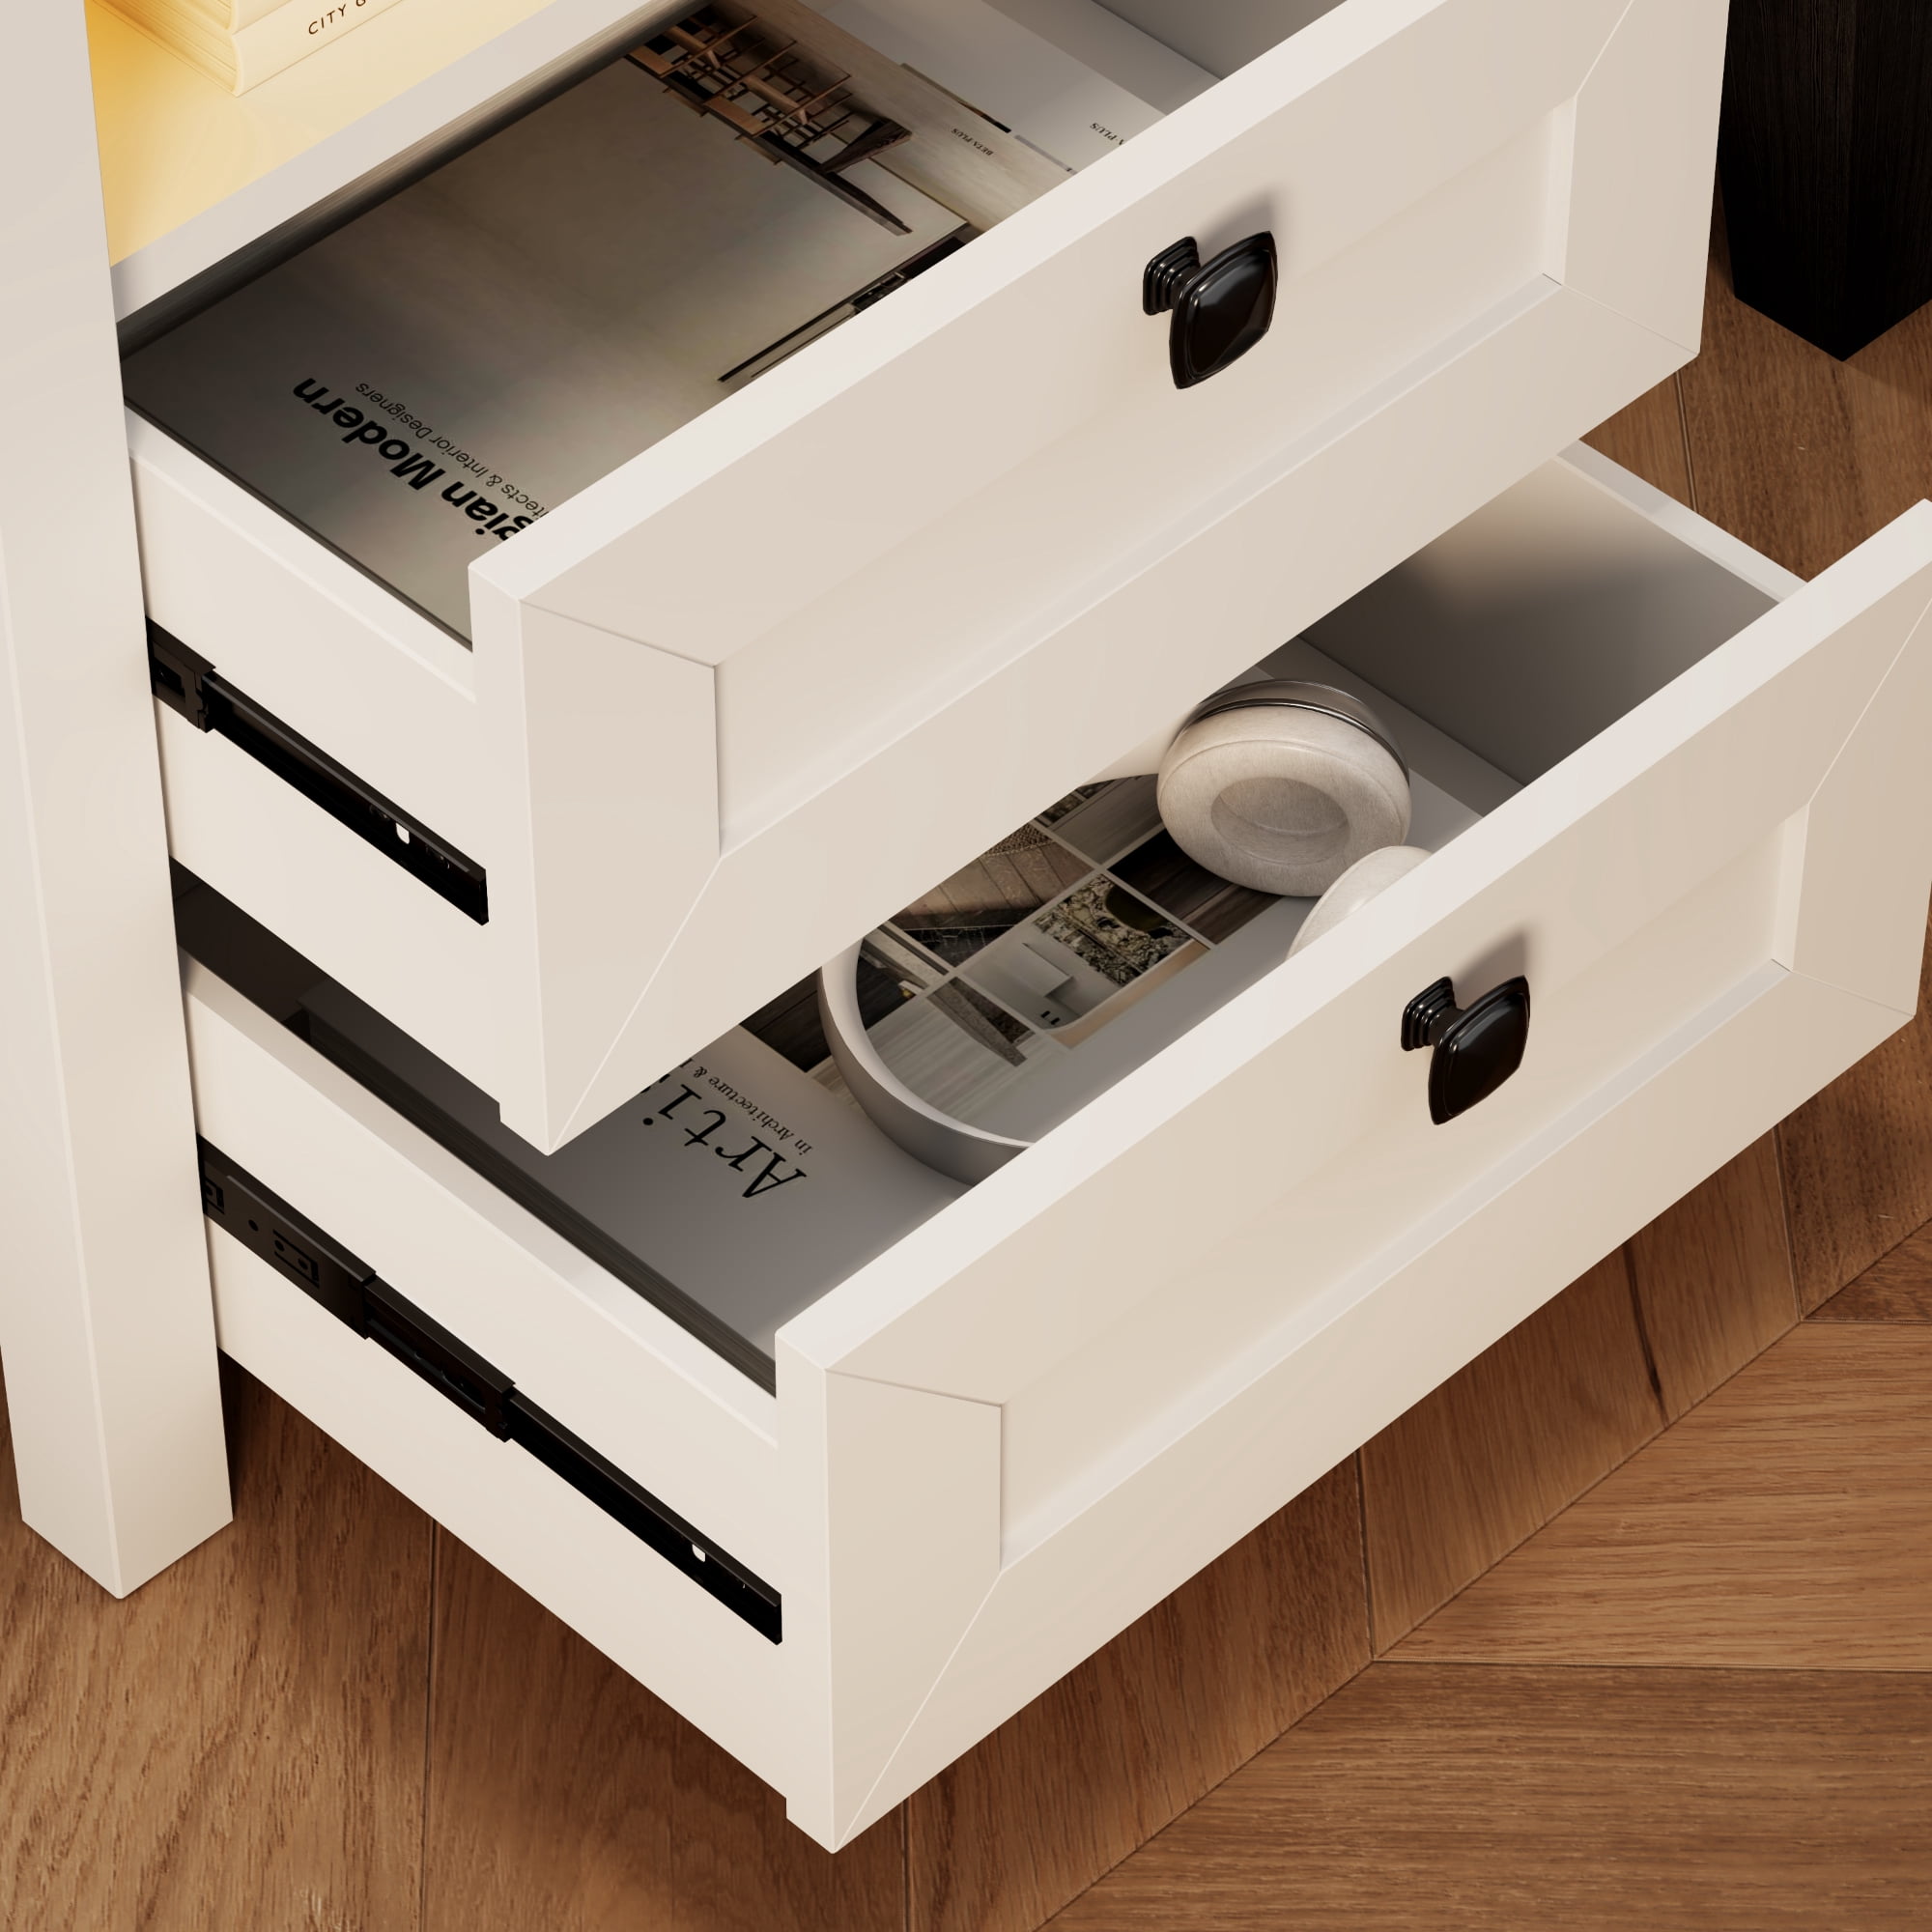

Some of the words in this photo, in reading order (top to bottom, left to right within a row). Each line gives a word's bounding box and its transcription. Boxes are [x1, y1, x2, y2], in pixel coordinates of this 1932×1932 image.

[308, 4, 346, 35] CITY
[355, 383, 433, 440] Designers
[292, 378, 446, 491] Modern
[429, 435, 489, 479] Interior
[486, 473, 503, 488] &
[693, 1066, 709, 1080] &
[708, 1076, 795, 1142] Architecture
[794, 1139, 813, 1156] in
